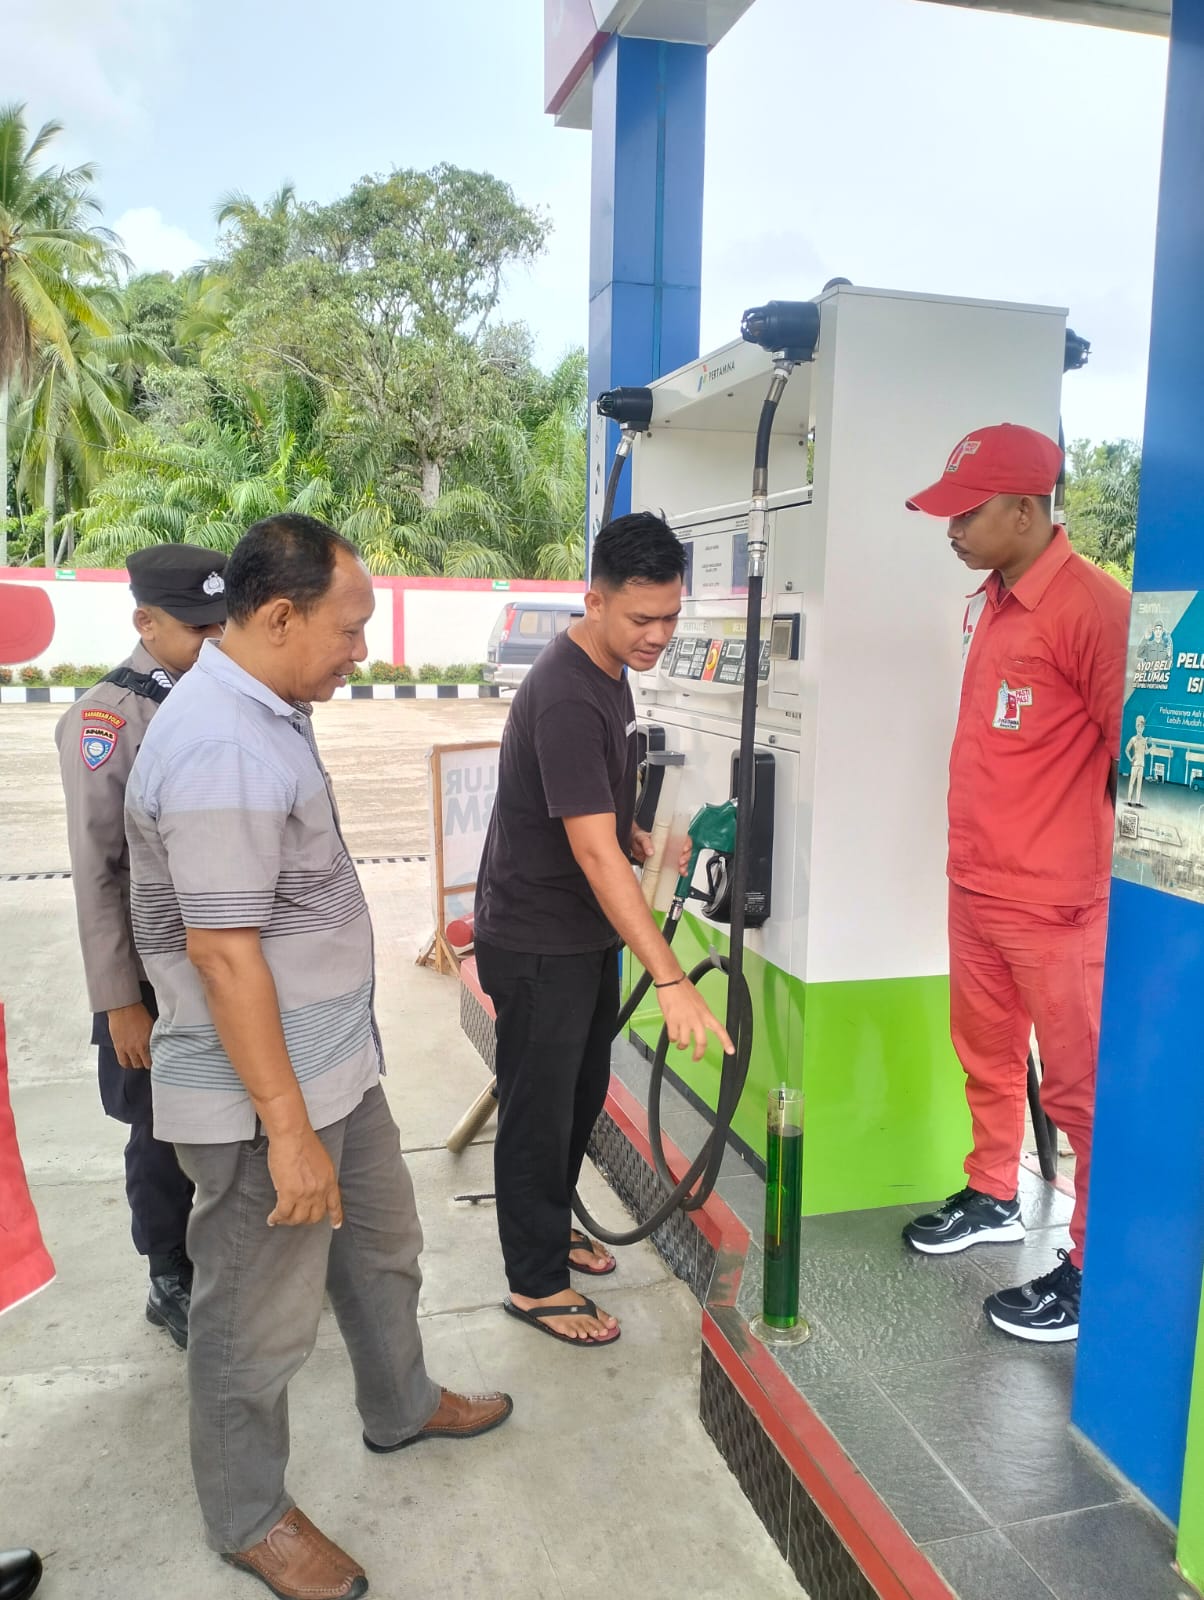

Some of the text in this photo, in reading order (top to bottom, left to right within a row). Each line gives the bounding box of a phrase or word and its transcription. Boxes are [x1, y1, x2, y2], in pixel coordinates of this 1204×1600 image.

[1153, 660, 1172, 671] BELI
[1134, 672, 1170, 683] PELUMAS
[1167, 715, 1181, 725] Lebih
